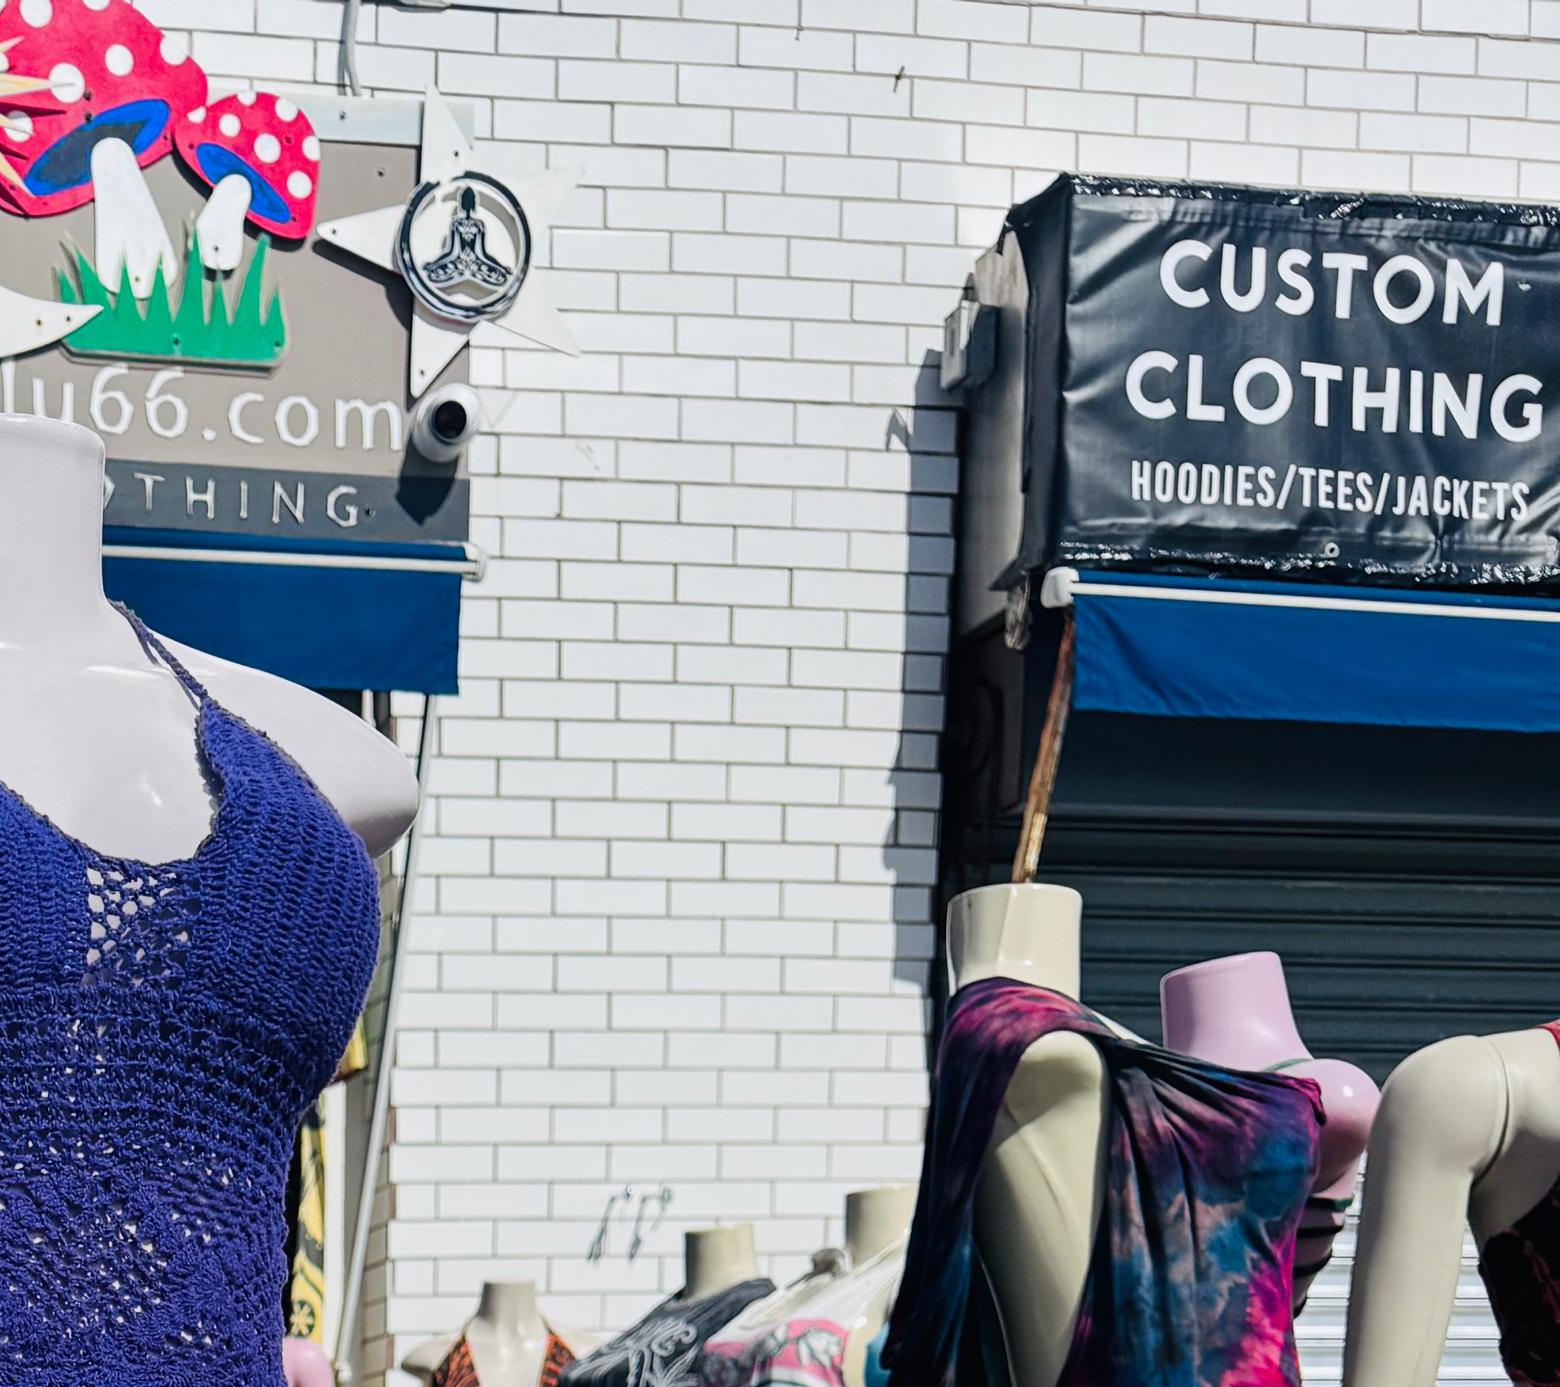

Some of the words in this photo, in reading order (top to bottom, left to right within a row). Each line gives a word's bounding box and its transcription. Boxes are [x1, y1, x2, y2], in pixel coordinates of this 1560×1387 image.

[1159, 239, 1504, 326] CUSTOM
[1125, 350, 1544, 443] CLOTHING
[105, 470, 360, 529] THING
[1131, 461, 1529, 520] HOODIES/TEES/JACKETS
